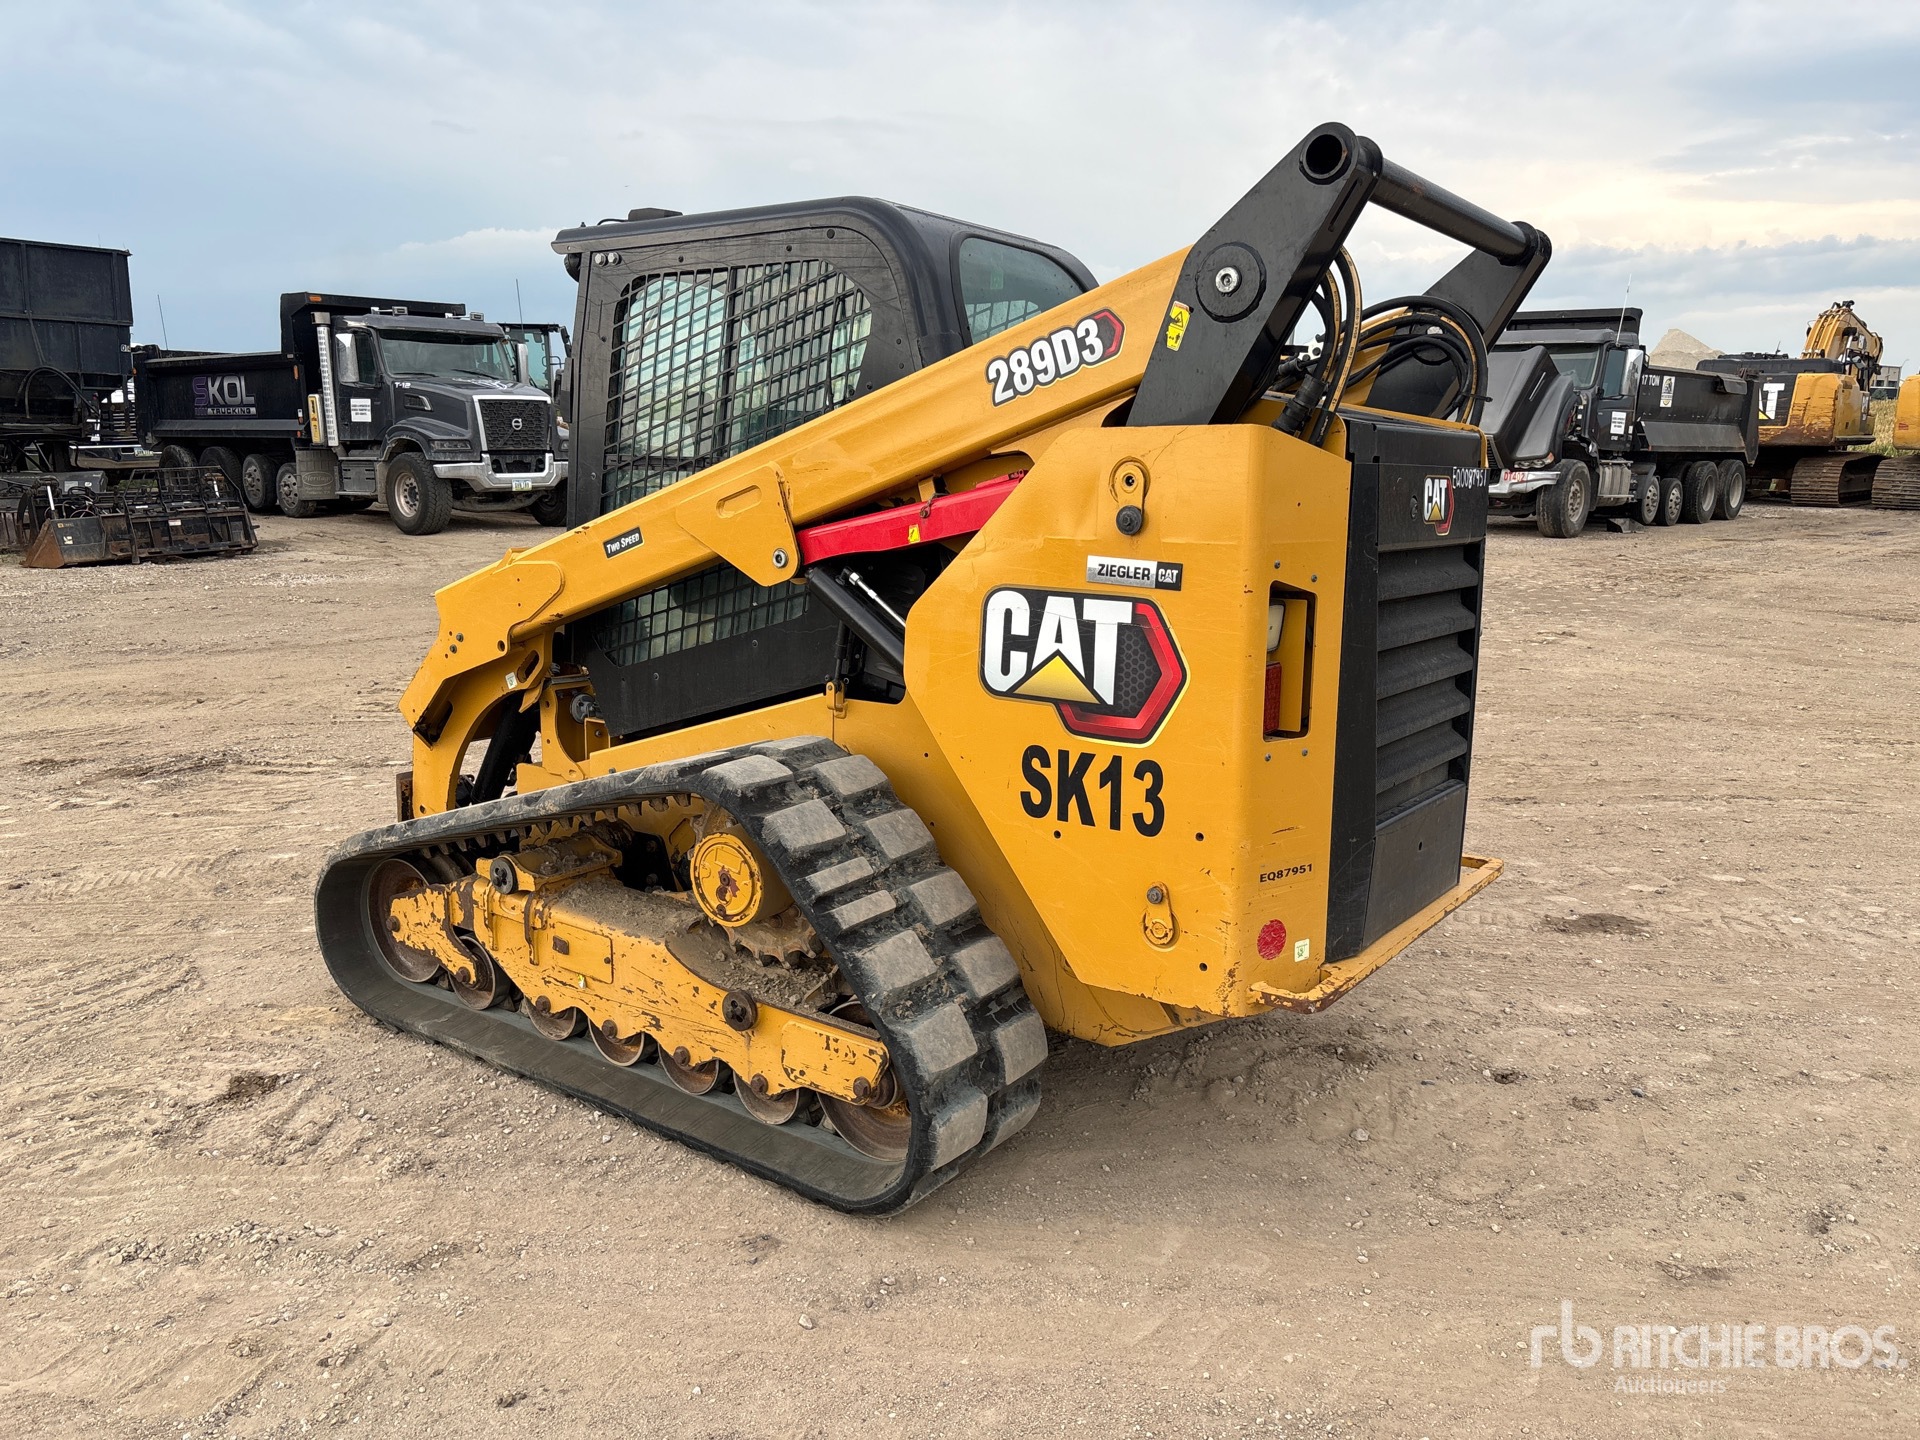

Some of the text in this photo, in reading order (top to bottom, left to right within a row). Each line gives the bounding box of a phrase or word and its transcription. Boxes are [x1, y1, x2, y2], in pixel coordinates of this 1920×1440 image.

[988, 319, 1104, 404] 289D3
[193, 375, 255, 406] SKOL
[1423, 477, 1448, 521] CAT
[1097, 563, 1179, 584] ZIEGLER CAT
[984, 590, 1133, 706] CAT
[1020, 744, 1165, 838] SK13
[1259, 863, 1313, 883] EQ87951
